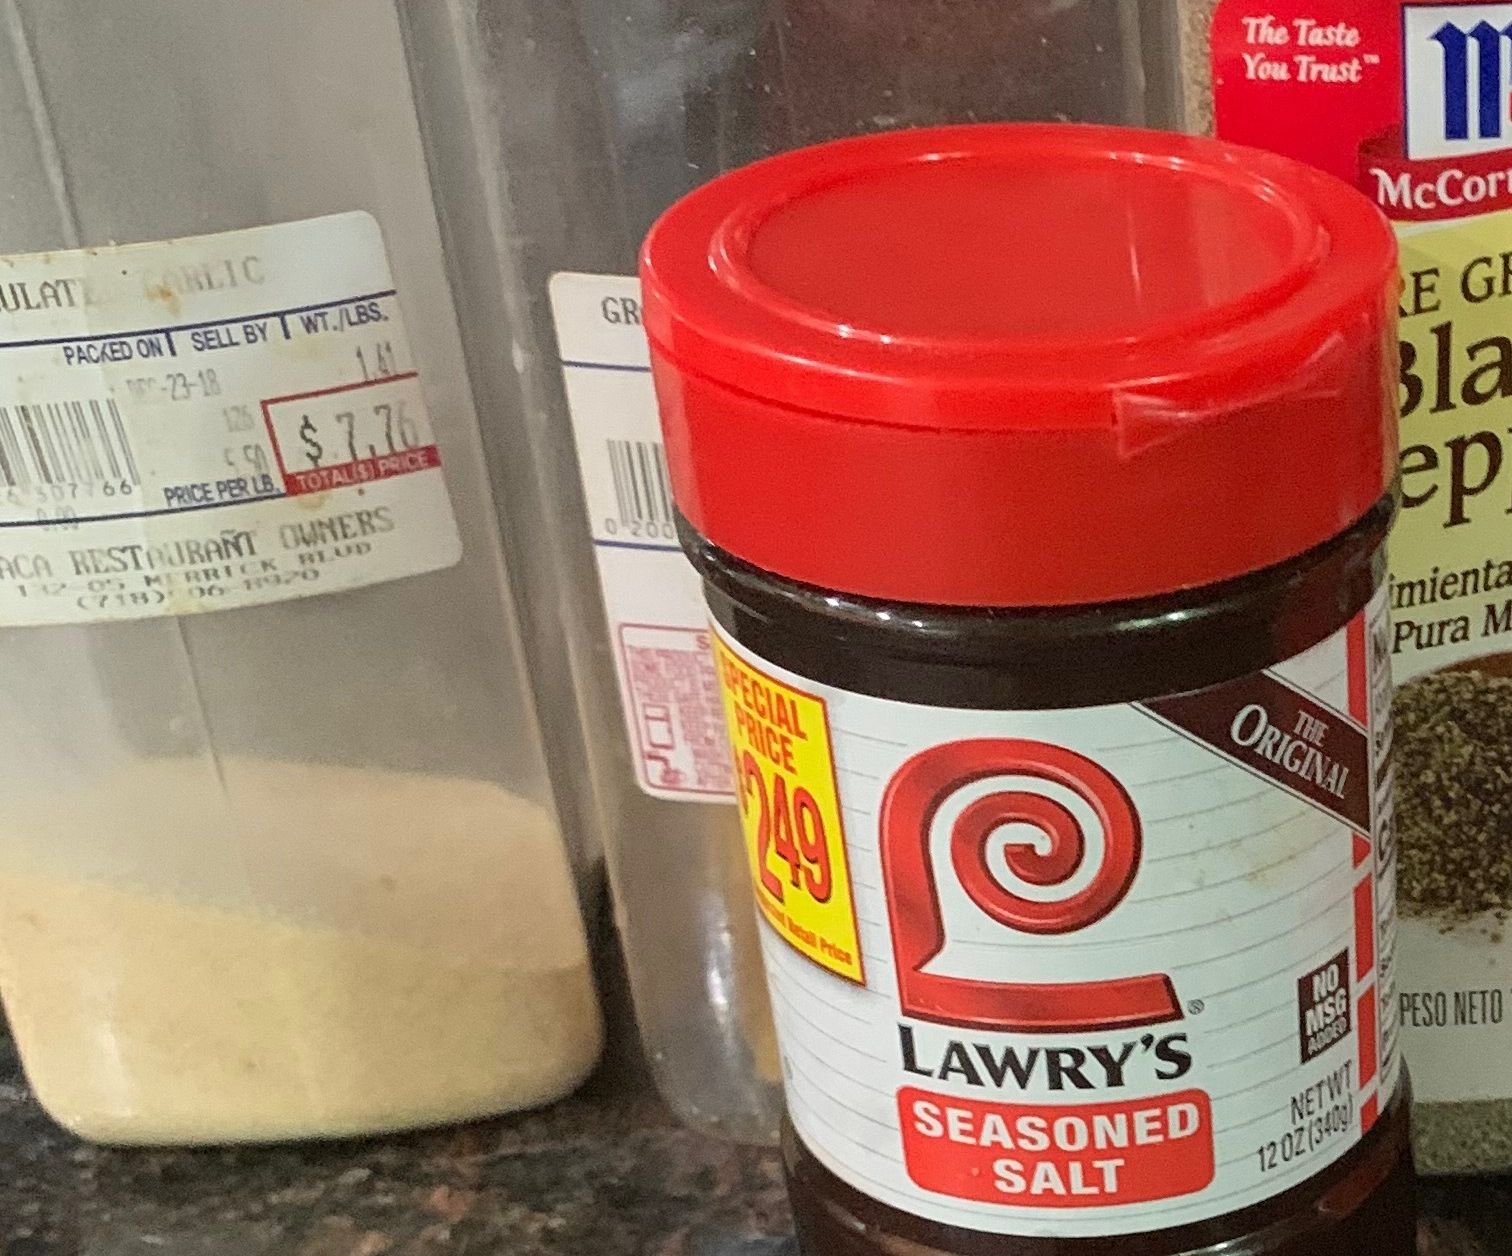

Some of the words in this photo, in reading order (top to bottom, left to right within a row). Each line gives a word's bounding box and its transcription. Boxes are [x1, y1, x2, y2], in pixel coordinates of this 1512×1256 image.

[1242, 16, 1290, 47] The
[1293, 18, 1359, 48] Taste
[1242, 53, 1292, 82] You
[601, 297, 643, 325] GR
[64, 340, 133, 366] PACKED
[137, 336, 163, 359] ON
[191, 329, 240, 352] SELL
[243, 321, 268, 345] BY
[379, 450, 431, 477] PRICE
[163, 484, 213, 507] PRICE
[216, 477, 249, 501] PER
[252, 473, 282, 495] LB.
[280, 506, 396, 551] OWNERS
[1392, 616, 1470, 655] Pura
[720, 651, 808, 741] SPECIAL
[734, 700, 798, 776] PRICE
[1294, 710, 1329, 748] THE
[1312, 963, 1340, 1001] NO
[1304, 987, 1348, 1038] MSG
[1400, 990, 1447, 1028] PESO
[1454, 988, 1502, 1024] NETO
[897, 1023, 1194, 1091] LAWRY'S
[1290, 1080, 1326, 1126] NET
[912, 1100, 1199, 1151] SEASONED
[1257, 1140, 1278, 1173] 12
[992, 1157, 1126, 1197] SALT
